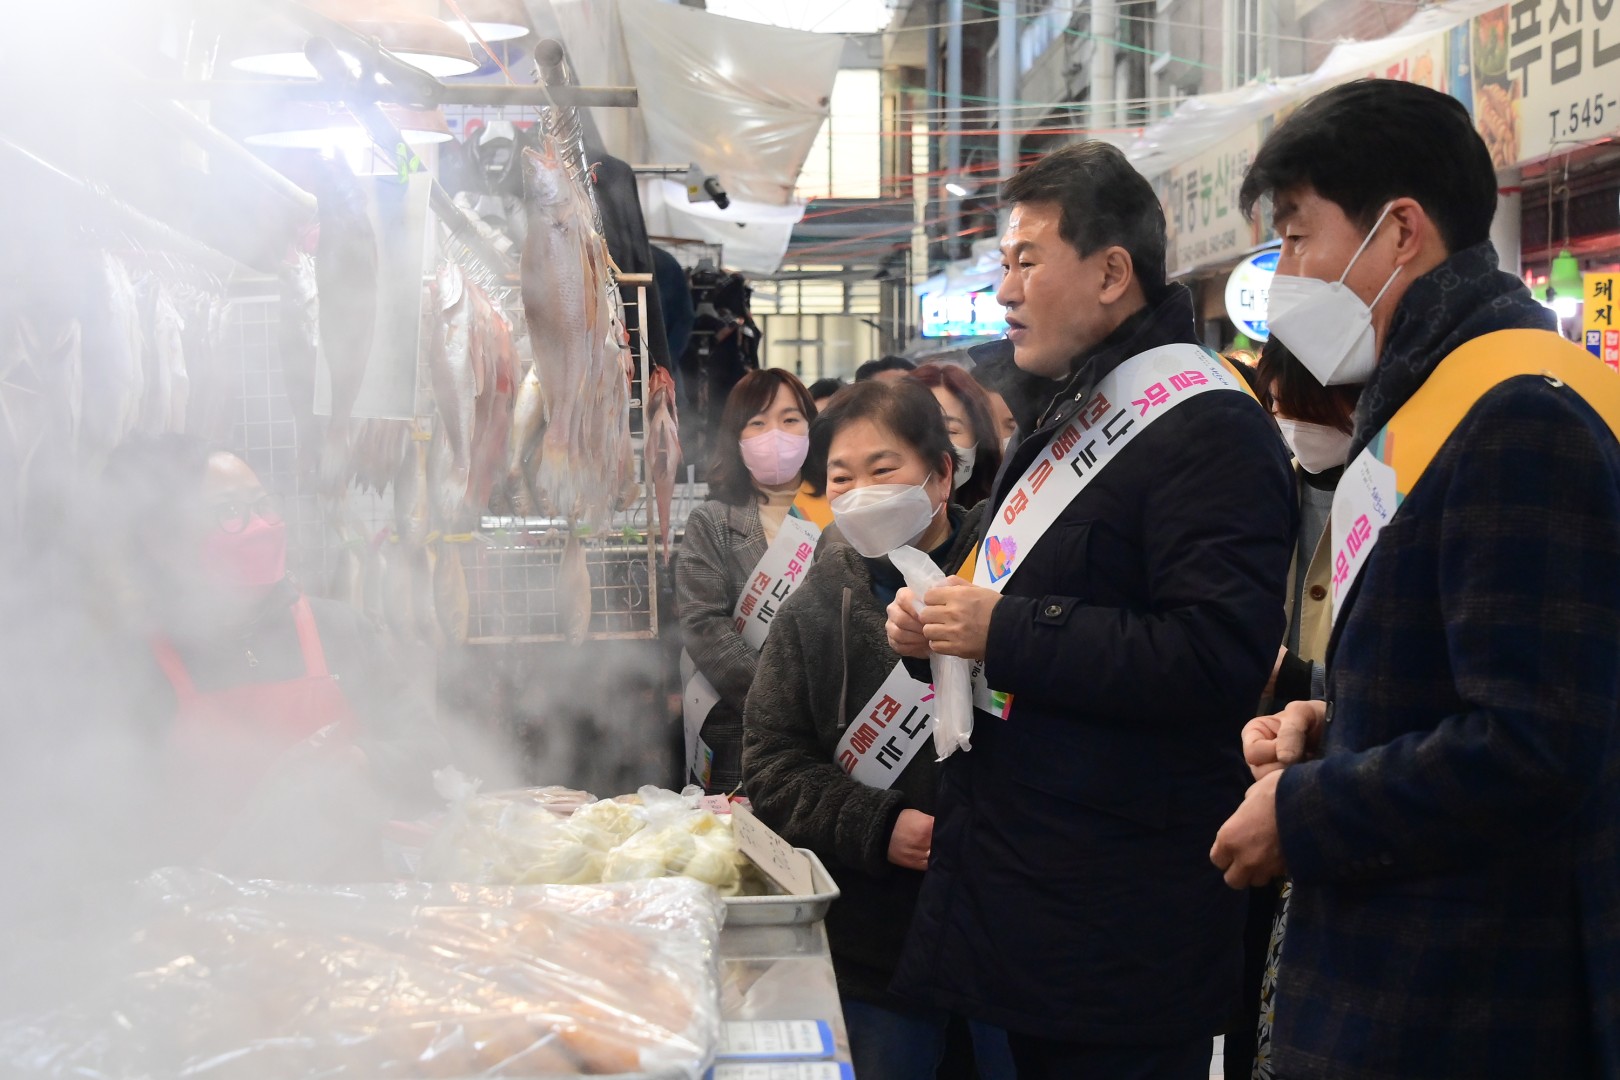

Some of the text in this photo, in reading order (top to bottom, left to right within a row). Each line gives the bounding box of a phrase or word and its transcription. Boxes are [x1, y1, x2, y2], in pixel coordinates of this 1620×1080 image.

[1593, 278, 1613, 326] 돼지
[1003, 391, 1112, 526] 전통시장
[734, 571, 772, 634] 전통시
[839, 693, 902, 776] 전통시
